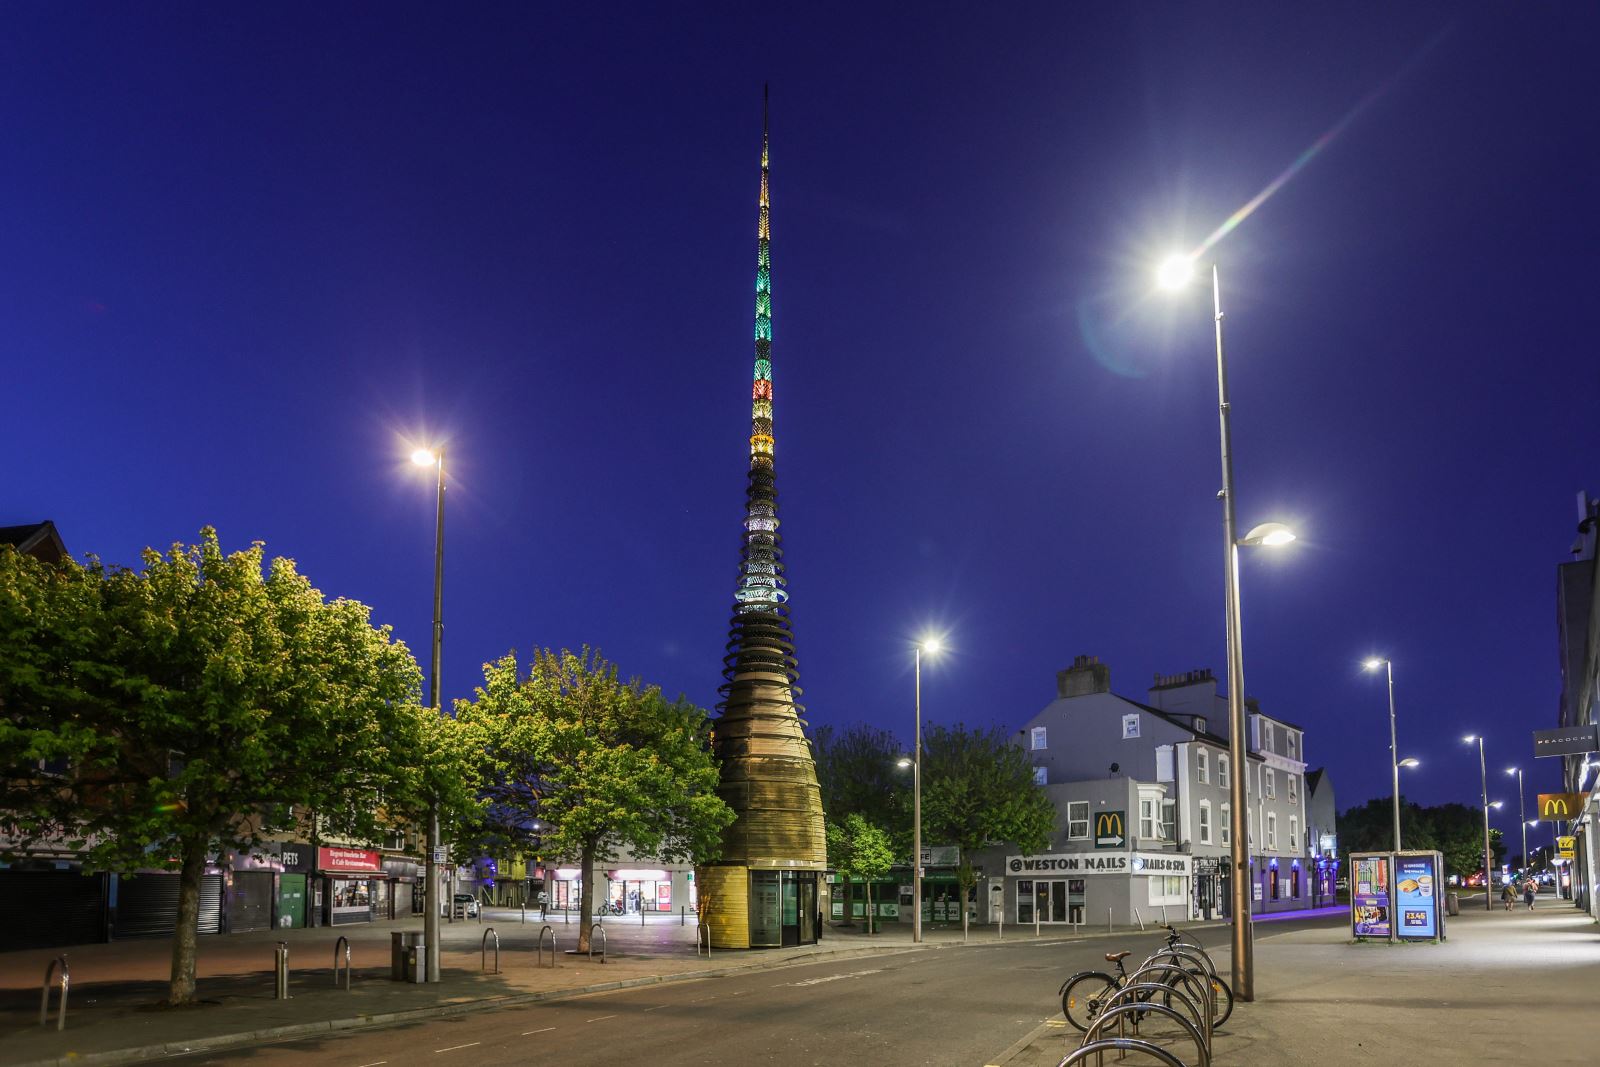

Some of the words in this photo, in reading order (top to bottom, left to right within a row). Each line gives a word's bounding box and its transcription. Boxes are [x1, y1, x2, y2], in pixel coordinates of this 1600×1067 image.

[1537, 736, 1592, 744] PEACOCKS
[283, 852, 298, 865] PETS
[1084, 857, 1126, 869] NAILS
[1173, 860, 1185, 871] SPA
